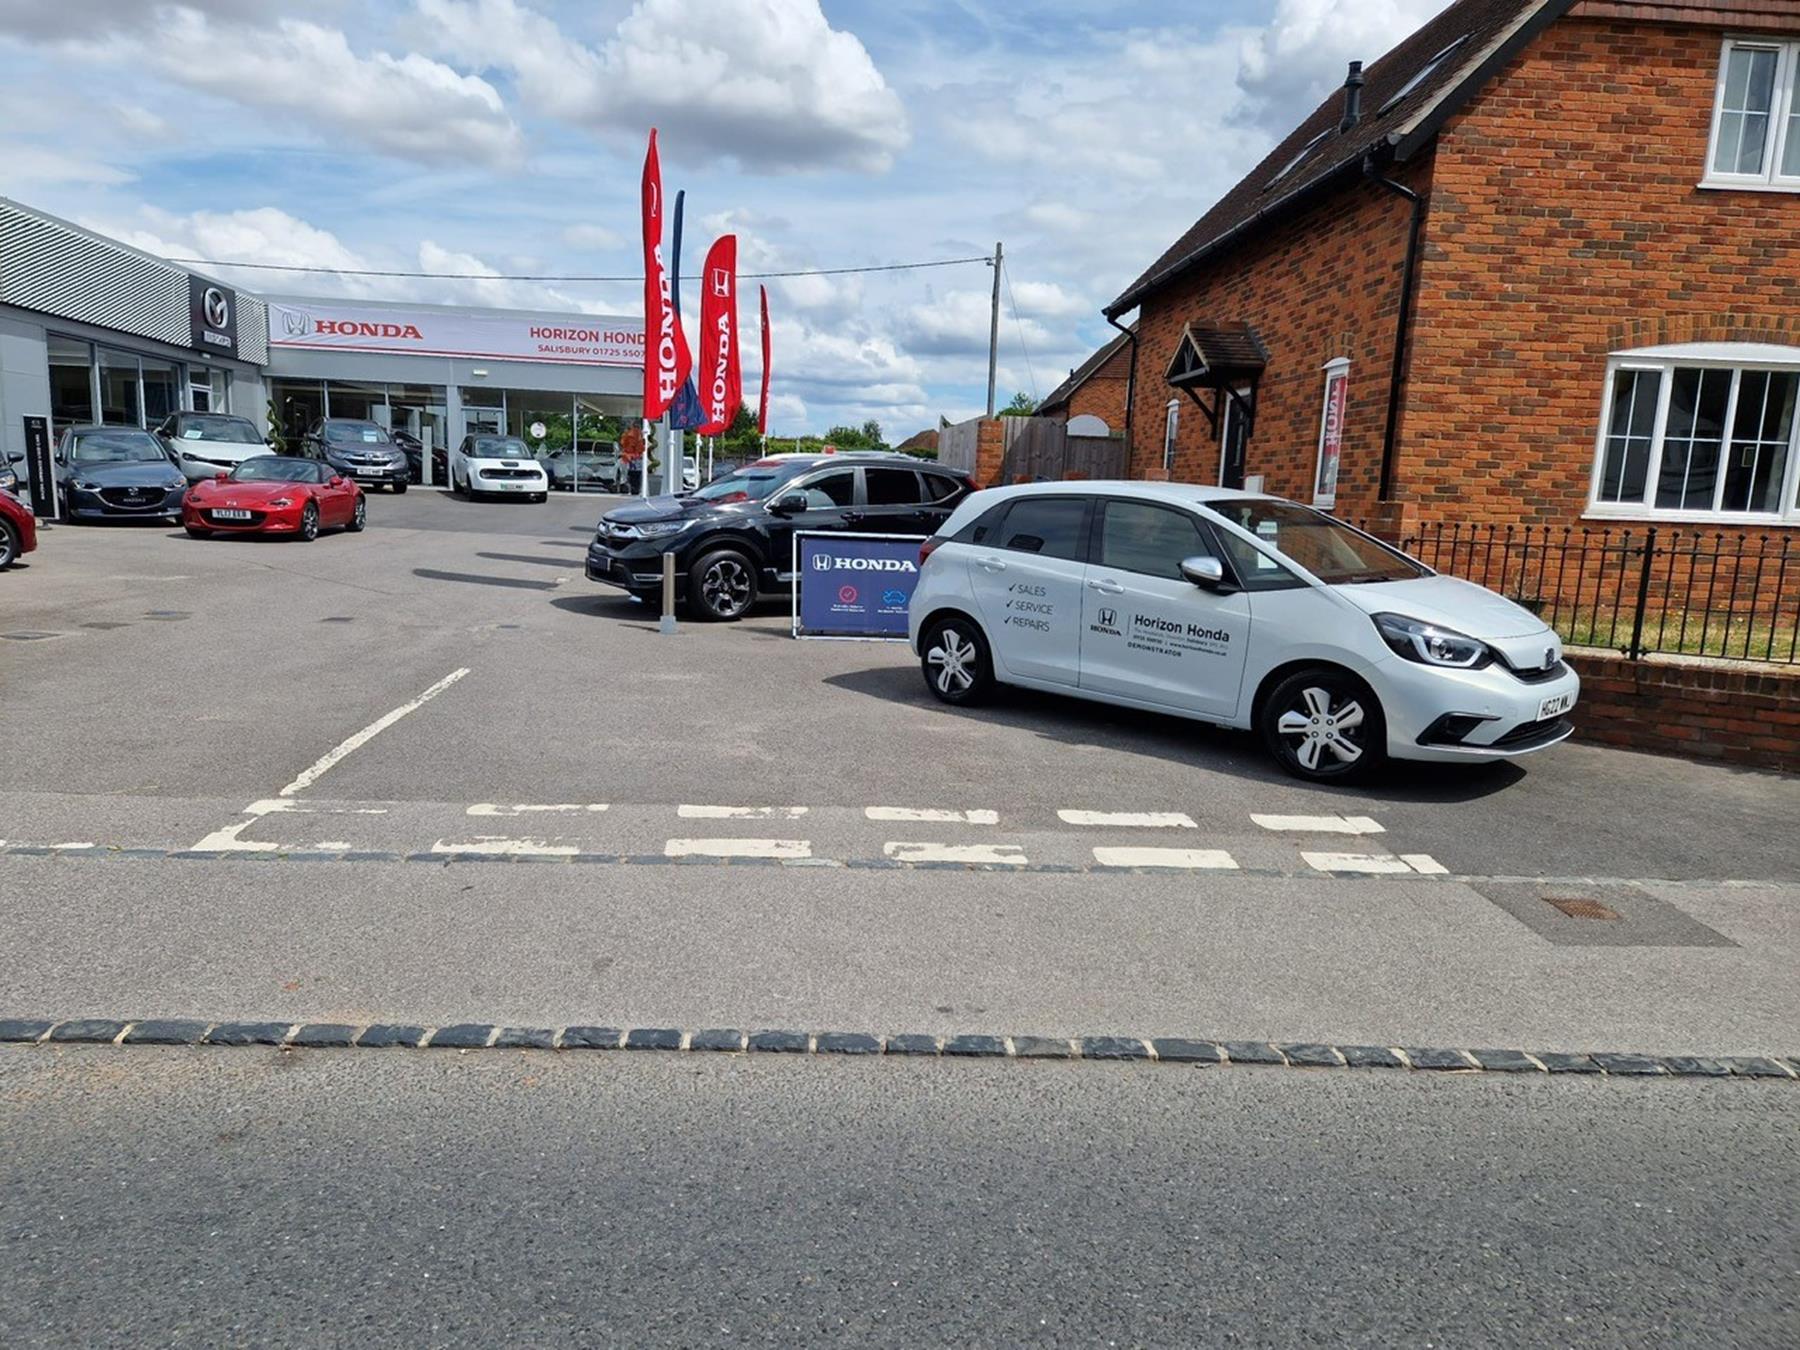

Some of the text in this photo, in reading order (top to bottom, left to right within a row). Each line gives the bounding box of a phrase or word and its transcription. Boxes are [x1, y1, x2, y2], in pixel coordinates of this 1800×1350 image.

[314, 319, 423, 340] HONDA
[530, 327, 645, 345] HORIZON HOND
[538, 344, 590, 355] SALISBURY
[592, 347, 621, 356] 01725
[711, 311, 730, 424] HONDA
[834, 557, 918, 573] HONDA
[1017, 584, 1047, 597] SALES
[1015, 600, 1054, 616] SERVICE
[1012, 616, 1050, 632] REPAIRS
[1090, 624, 1122, 637] HONDA
[1134, 614, 1183, 634] Horizon
[1187, 623, 1231, 643] Honda
[1127, 641, 1182, 657] DEMONSTRATOR
